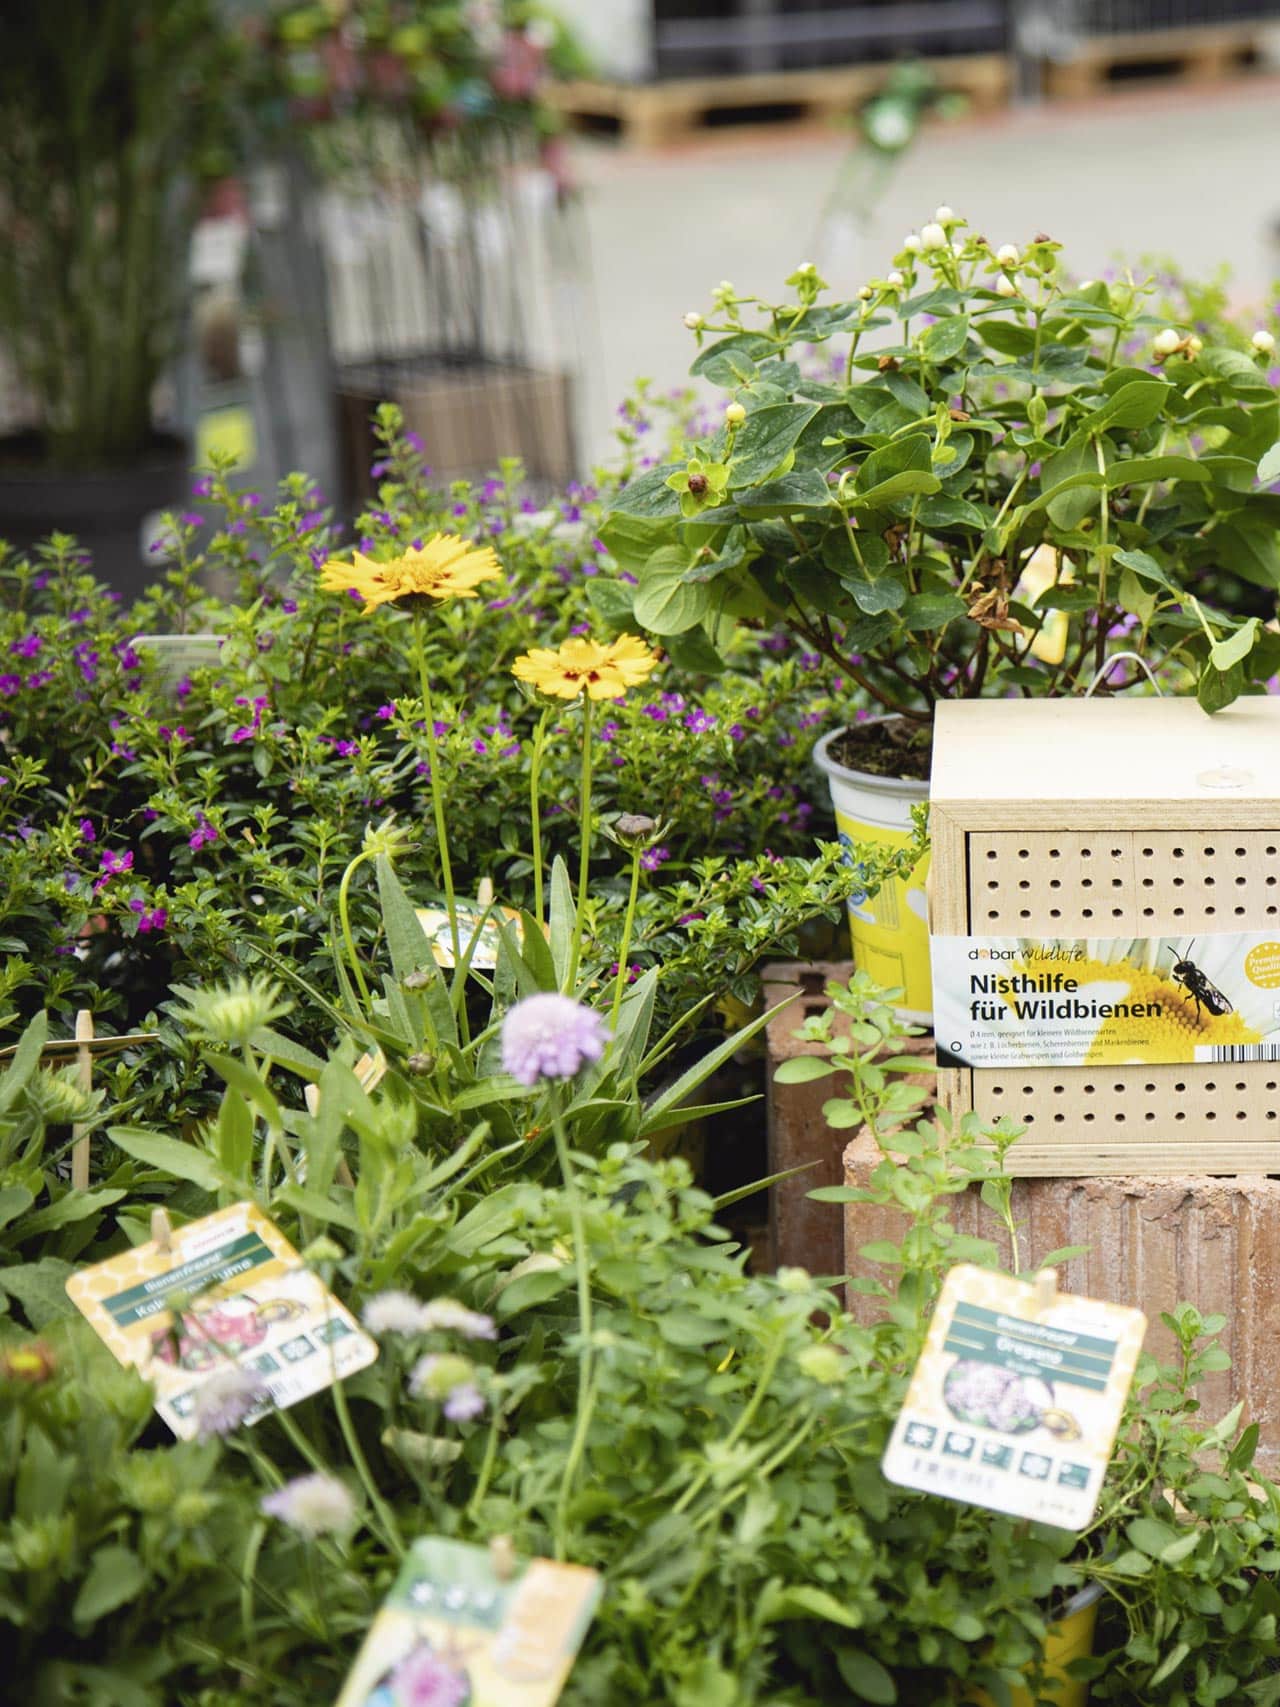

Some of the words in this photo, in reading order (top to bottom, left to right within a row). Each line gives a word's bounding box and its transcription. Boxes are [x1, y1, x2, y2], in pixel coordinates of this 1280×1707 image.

[1020, 945, 1082, 964] wildlife
[969, 974, 1079, 994] Nisthilfe
[969, 1001, 1007, 1021] für
[1013, 999, 1162, 1020] Wildbienen
